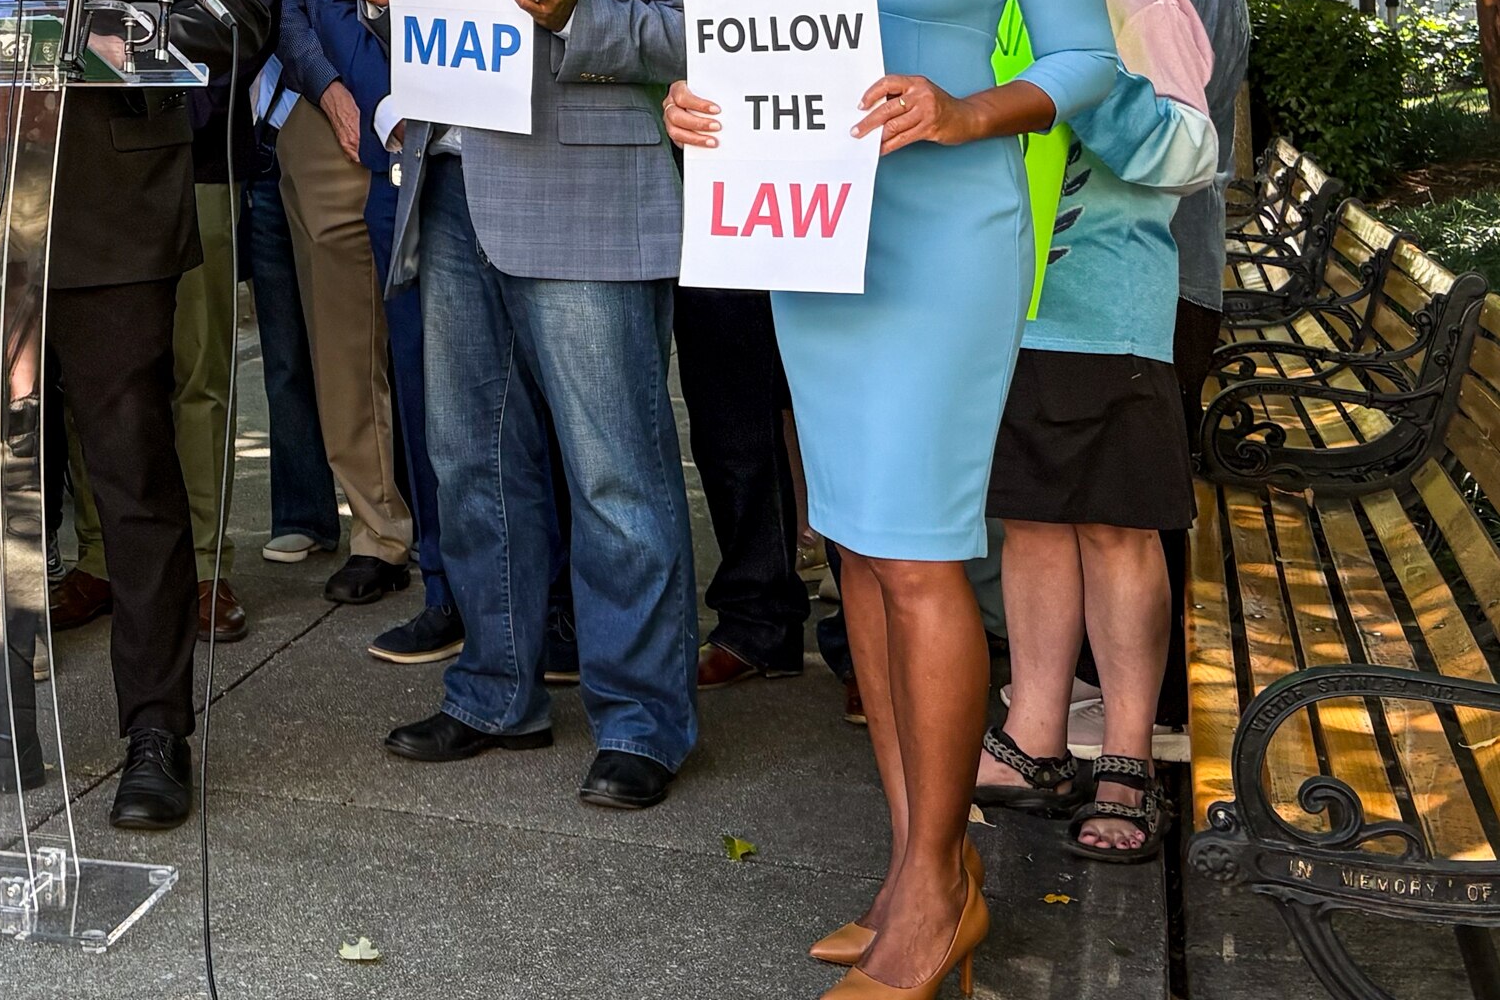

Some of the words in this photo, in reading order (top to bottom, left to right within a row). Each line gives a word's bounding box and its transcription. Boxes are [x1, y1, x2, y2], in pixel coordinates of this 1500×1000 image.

[403, 15, 522, 73] MAP
[696, 12, 864, 54] FOLLOW
[744, 94, 826, 131] THE
[710, 181, 852, 238] LAW
[1317, 676, 1408, 694] STANLEY
[1289, 859, 1314, 879] IN
[1342, 870, 1439, 897] MEMORY
[1466, 883, 1493, 902] OF
